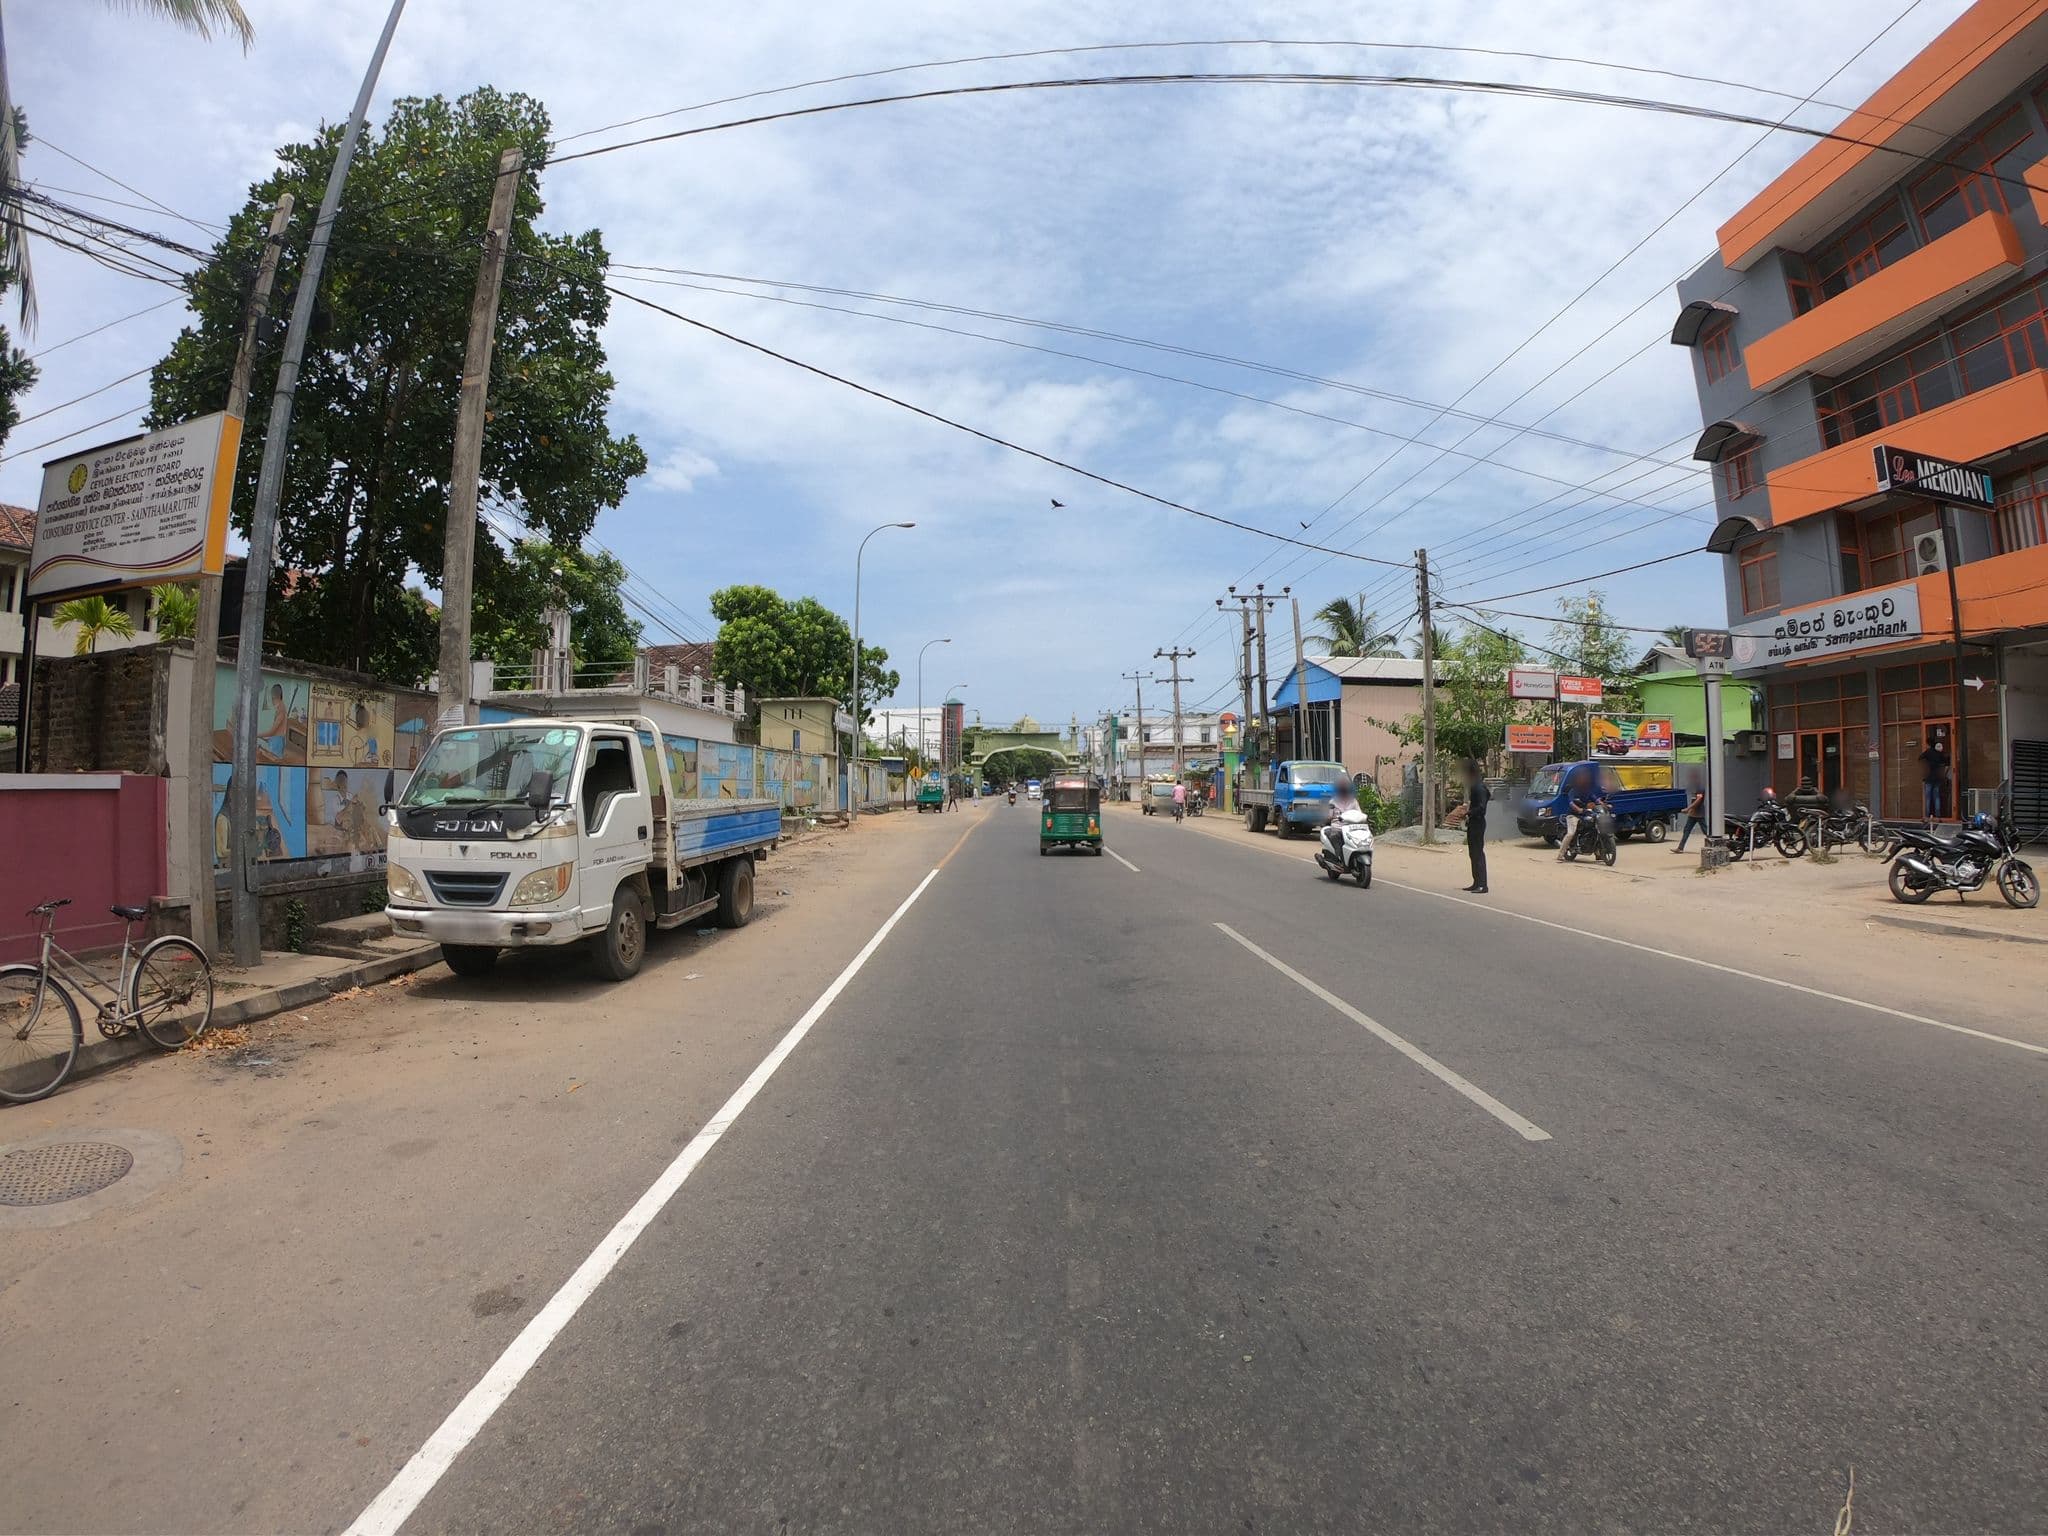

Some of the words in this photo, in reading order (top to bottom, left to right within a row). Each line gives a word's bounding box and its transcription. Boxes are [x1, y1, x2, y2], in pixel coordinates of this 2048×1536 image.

[90, 476, 115, 490] CEYLON
[115, 467, 155, 484] ELECTRICITY
[156, 460, 182, 475] BOARD
[1917, 458, 1984, 501] MERIDIAN
[42, 524, 75, 541] CONSUMER
[75, 518, 101, 535] SERVICE
[100, 511, 126, 528] CENTER
[131, 494, 201, 522] SAINTHAMARUTHU
[1708, 661, 1724, 670] ATM
[432, 819, 504, 833] FOTON
[489, 851, 538, 860] FORLAND
